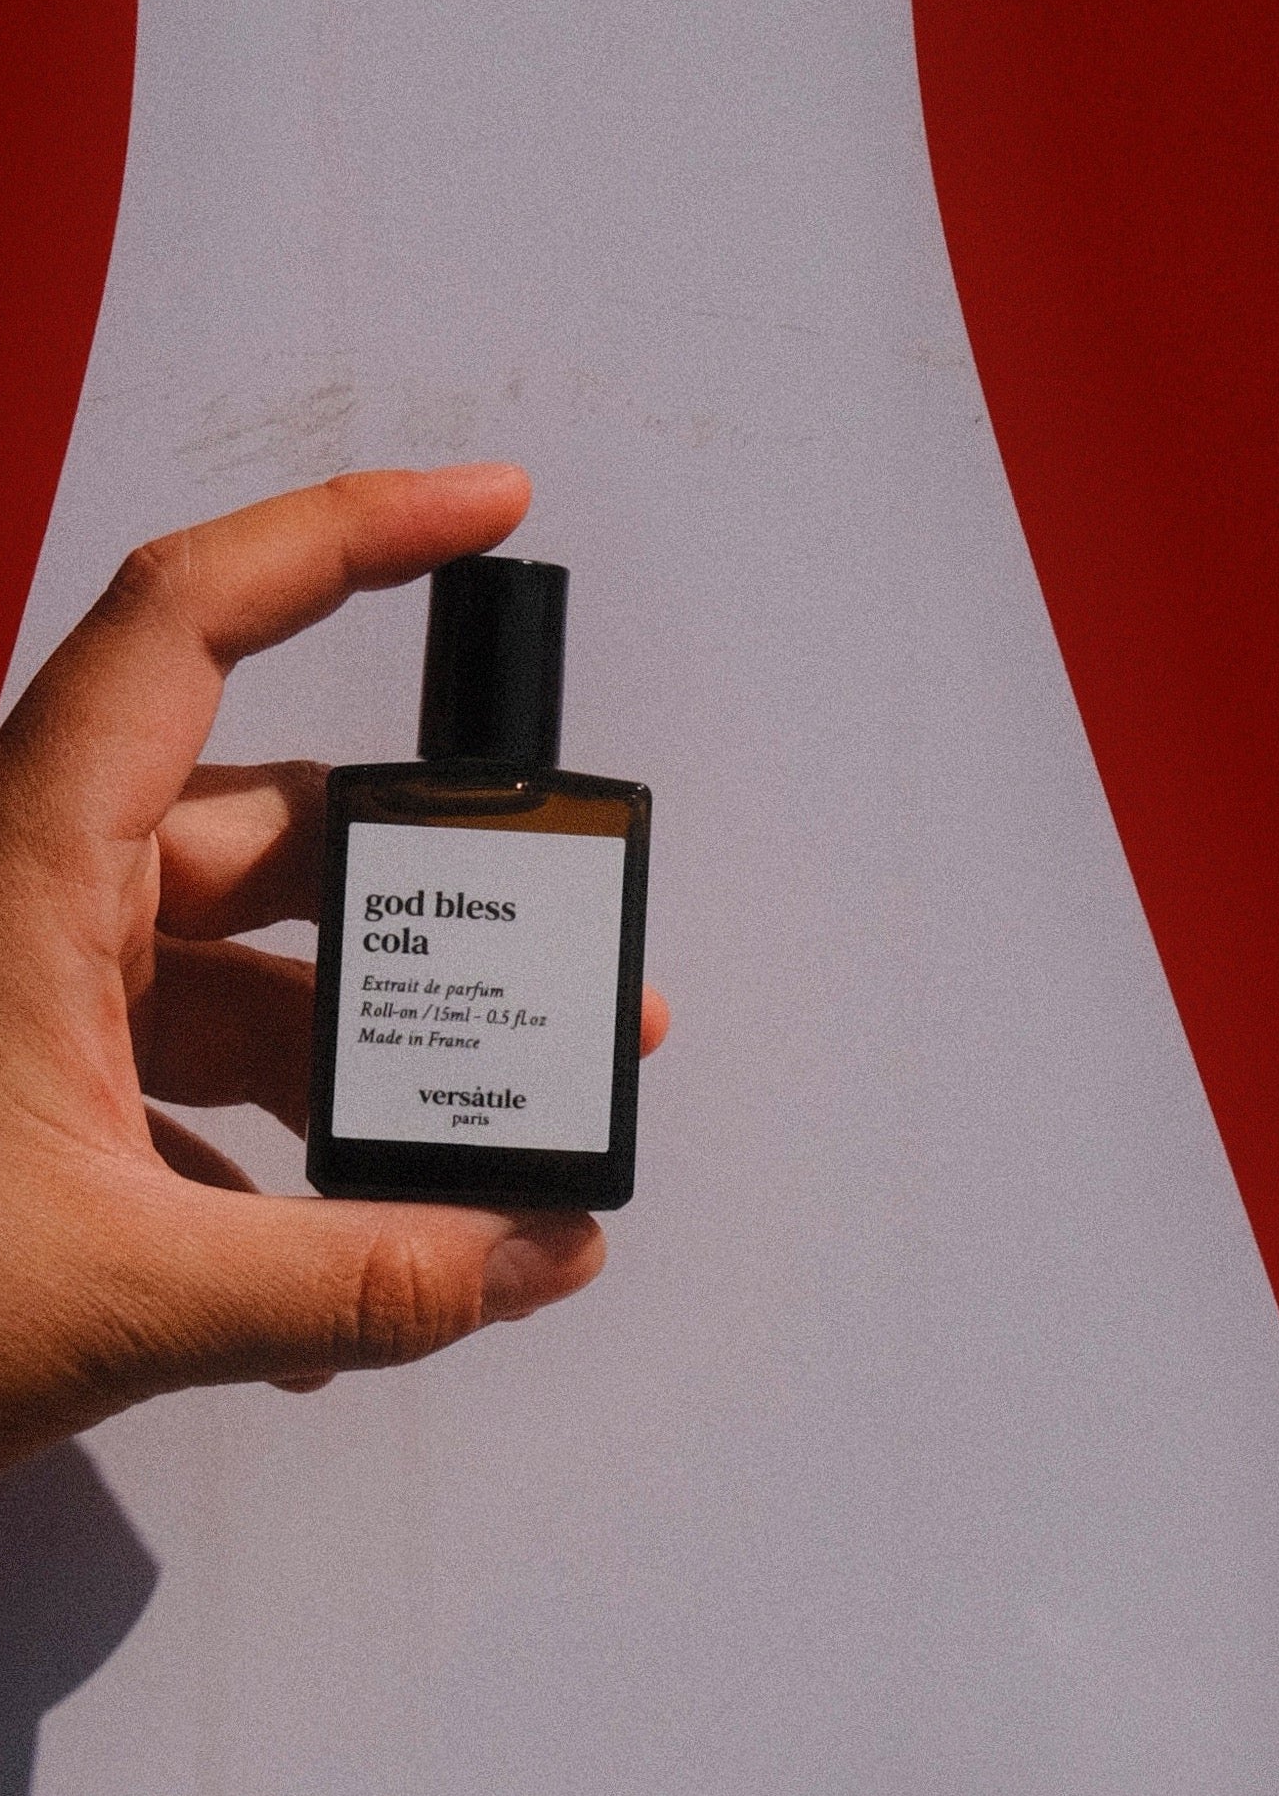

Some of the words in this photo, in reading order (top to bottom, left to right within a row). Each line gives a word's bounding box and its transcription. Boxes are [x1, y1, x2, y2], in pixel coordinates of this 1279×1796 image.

[364, 890, 425, 922] god
[435, 891, 516, 922] bless
[363, 927, 429, 956] cola
[361, 975, 419, 993] Extrait
[423, 978, 441, 994] de
[445, 981, 504, 1001] parfum
[360, 1001, 418, 1019] Roll-on
[357, 1028, 403, 1045] Made
[408, 1030, 423, 1046] in
[428, 1031, 481, 1049] France
[451, 1112, 490, 1128] paris
